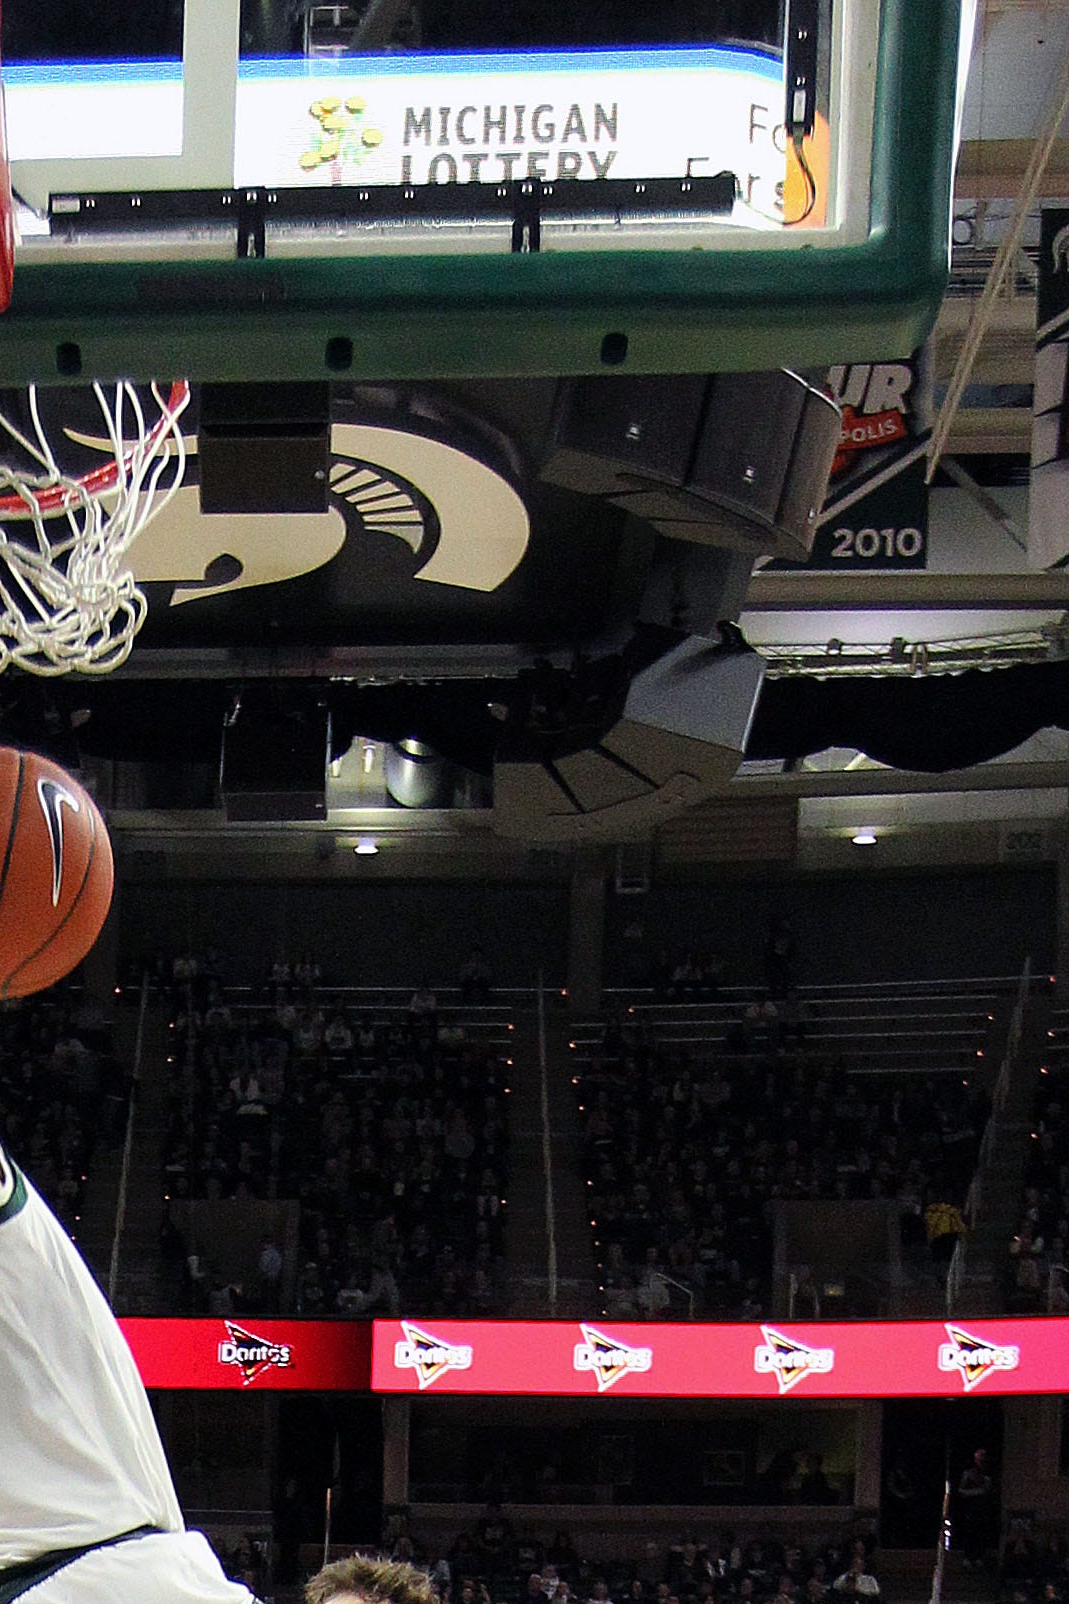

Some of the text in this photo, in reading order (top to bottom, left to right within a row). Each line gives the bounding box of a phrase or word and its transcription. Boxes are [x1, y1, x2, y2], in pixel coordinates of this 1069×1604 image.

[401, 101, 619, 147] MICHIGAN
[831, 527, 923, 558] 2010
[220, 1343, 290, 1365] Doritos
[398, 1344, 470, 1367] Doritos
[576, 1347, 650, 1370] Doritos
[761, 1350, 832, 1371] Doritos
[944, 1347, 1017, 1369] Doritos
